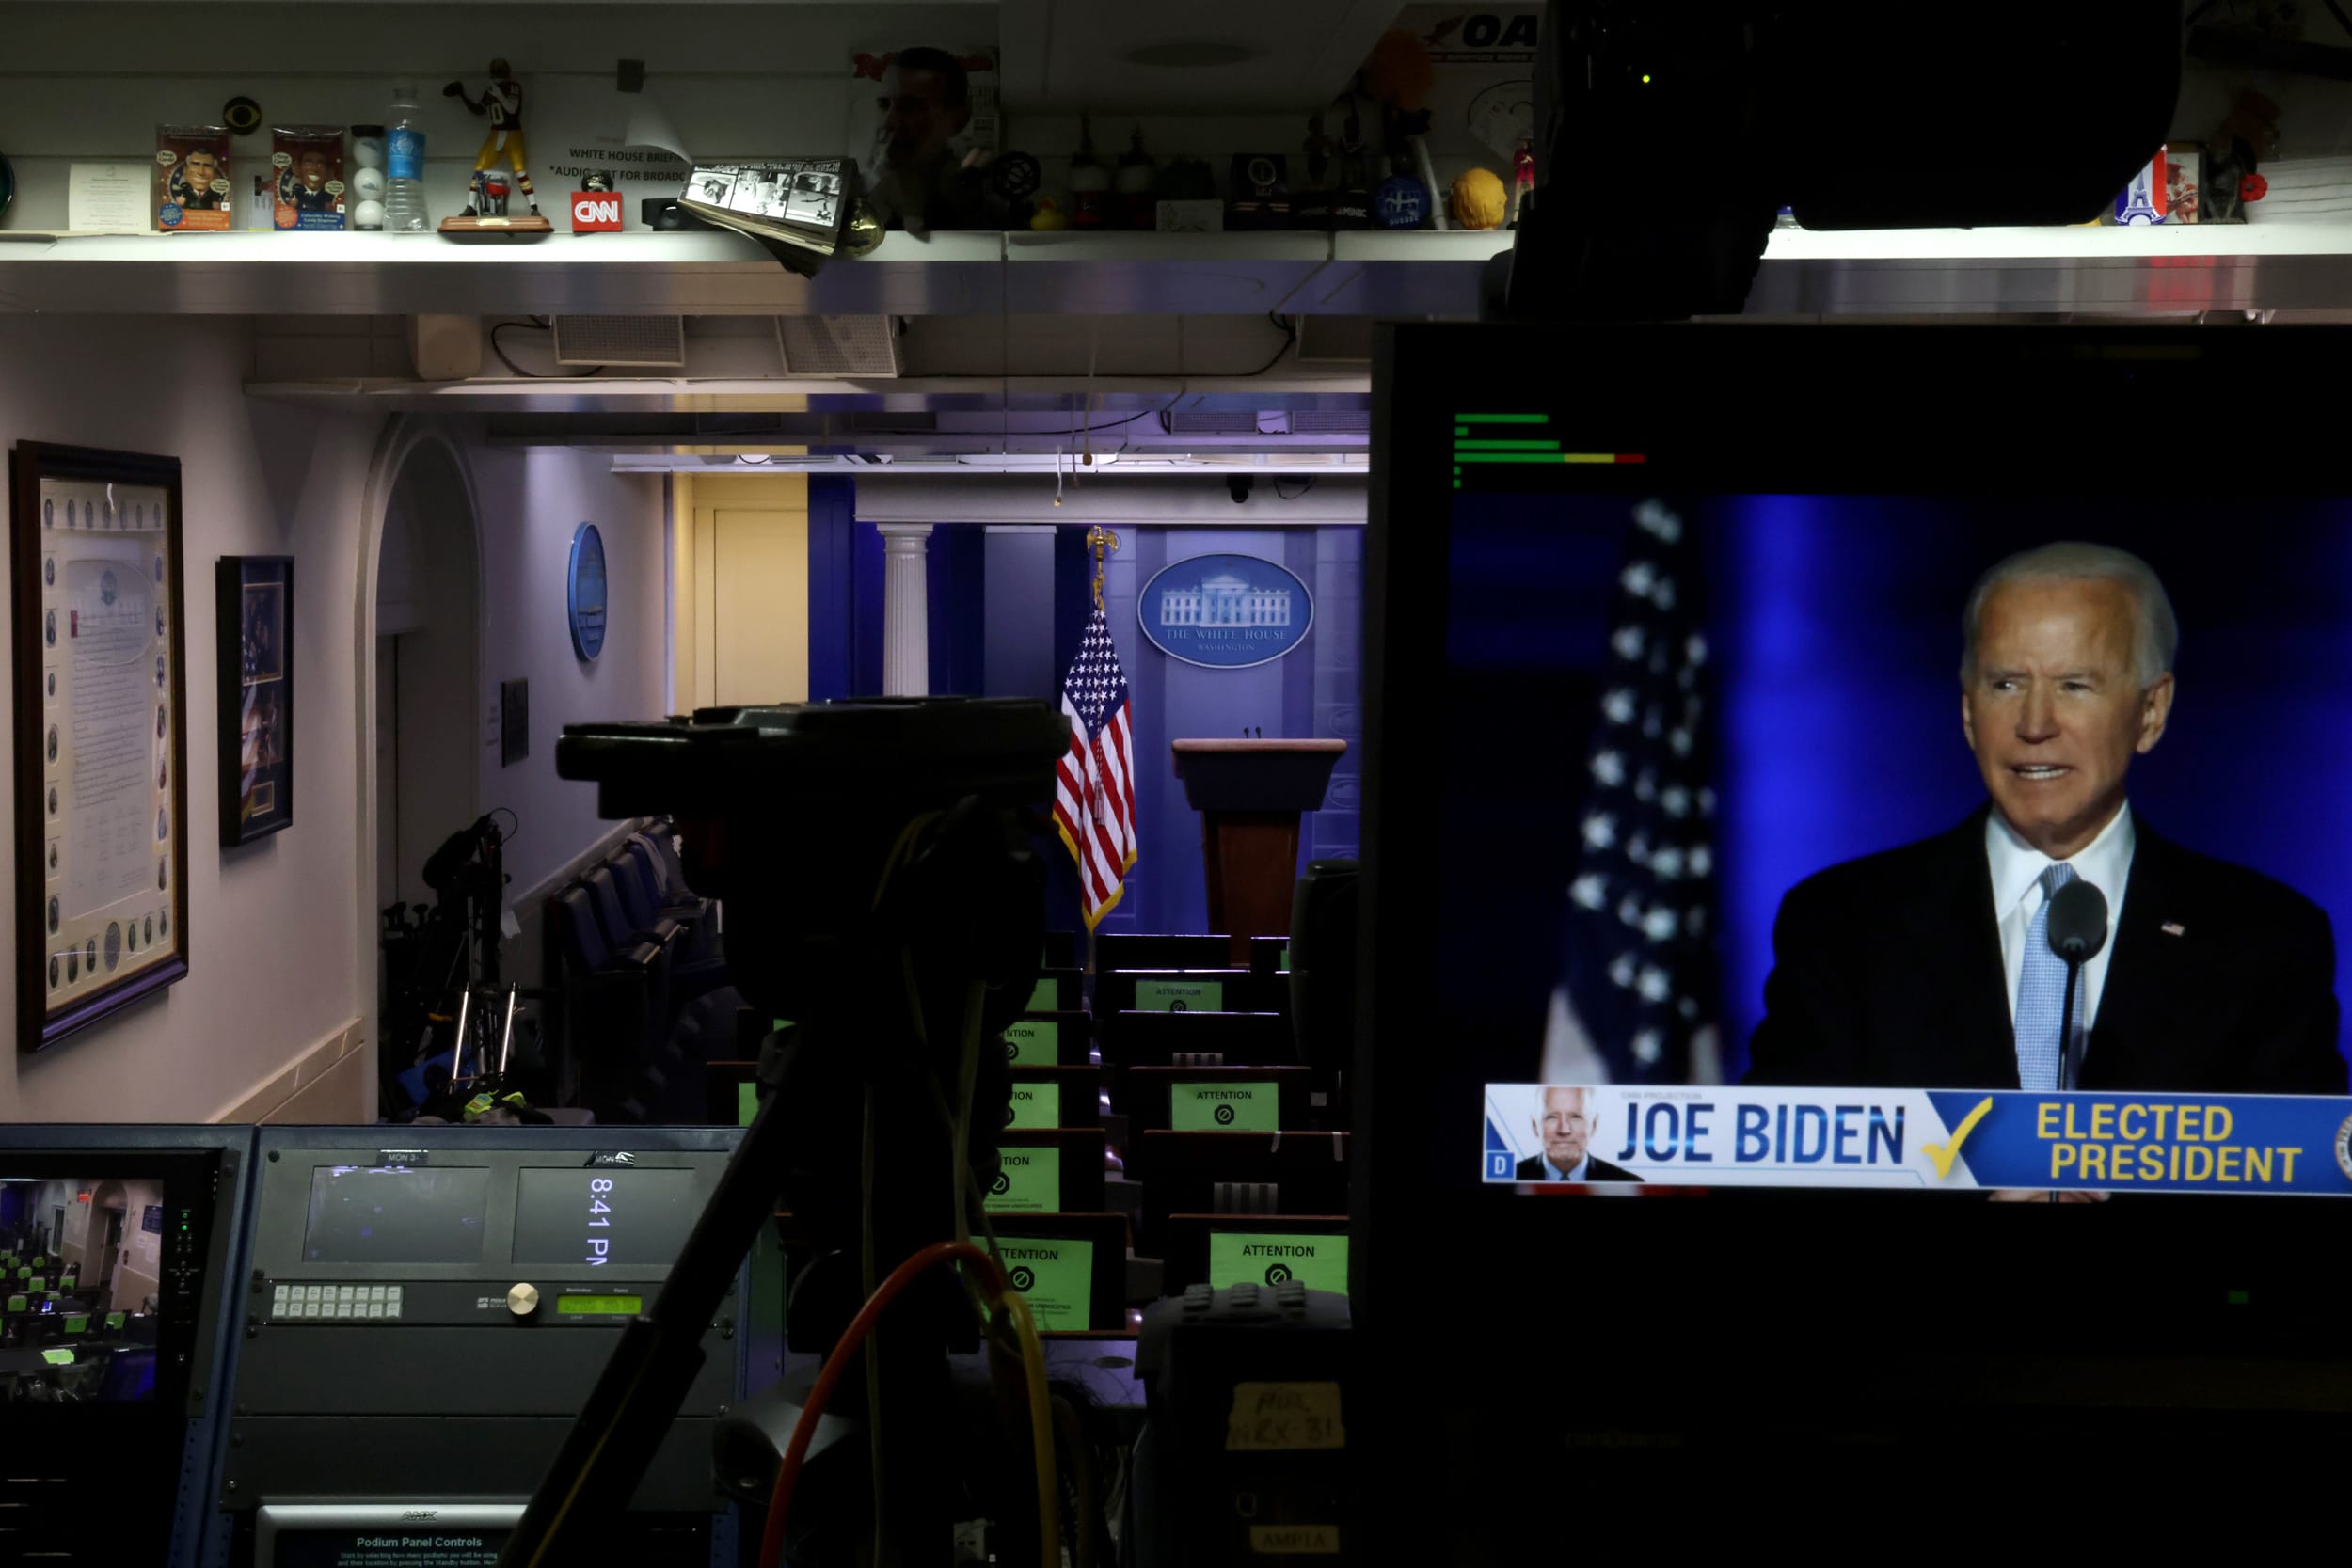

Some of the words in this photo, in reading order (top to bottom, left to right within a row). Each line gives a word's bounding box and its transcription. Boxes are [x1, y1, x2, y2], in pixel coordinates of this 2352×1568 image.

[1463, 14, 1537, 47] OA
[569, 148, 605, 160] WHITE
[608, 150, 644, 162] HOUSE
[647, 152, 687, 163] BRIEFIN
[620, 170, 641, 181] FOR
[644, 171, 686, 182] BROADC
[574, 200, 618, 223] CNN
[1166, 629, 1190, 640] THE
[1196, 629, 1239, 640] WHITE
[1244, 629, 1288, 640] HOUSE
[1197, 643, 1255, 652] WASHINGTON
[1196, 1090, 1252, 1100] ATTENTION
[2037, 1102, 2233, 1142] ELECTED
[1617, 1101, 1715, 1162] JOE
[1734, 1103, 1906, 1165] BIDEN
[1493, 1156, 1507, 1176] D
[2050, 1143, 2303, 1183] PRESIDENT
[589, 1178, 613, 1227] 8:41
[999, 1247, 1059, 1260] TENTION
[1243, 1244, 1315, 1257] ATTENTION
[357, 1536, 399, 1547] Podium
[402, 1536, 433, 1547] Panel
[435, 1536, 483, 1547] Controls
